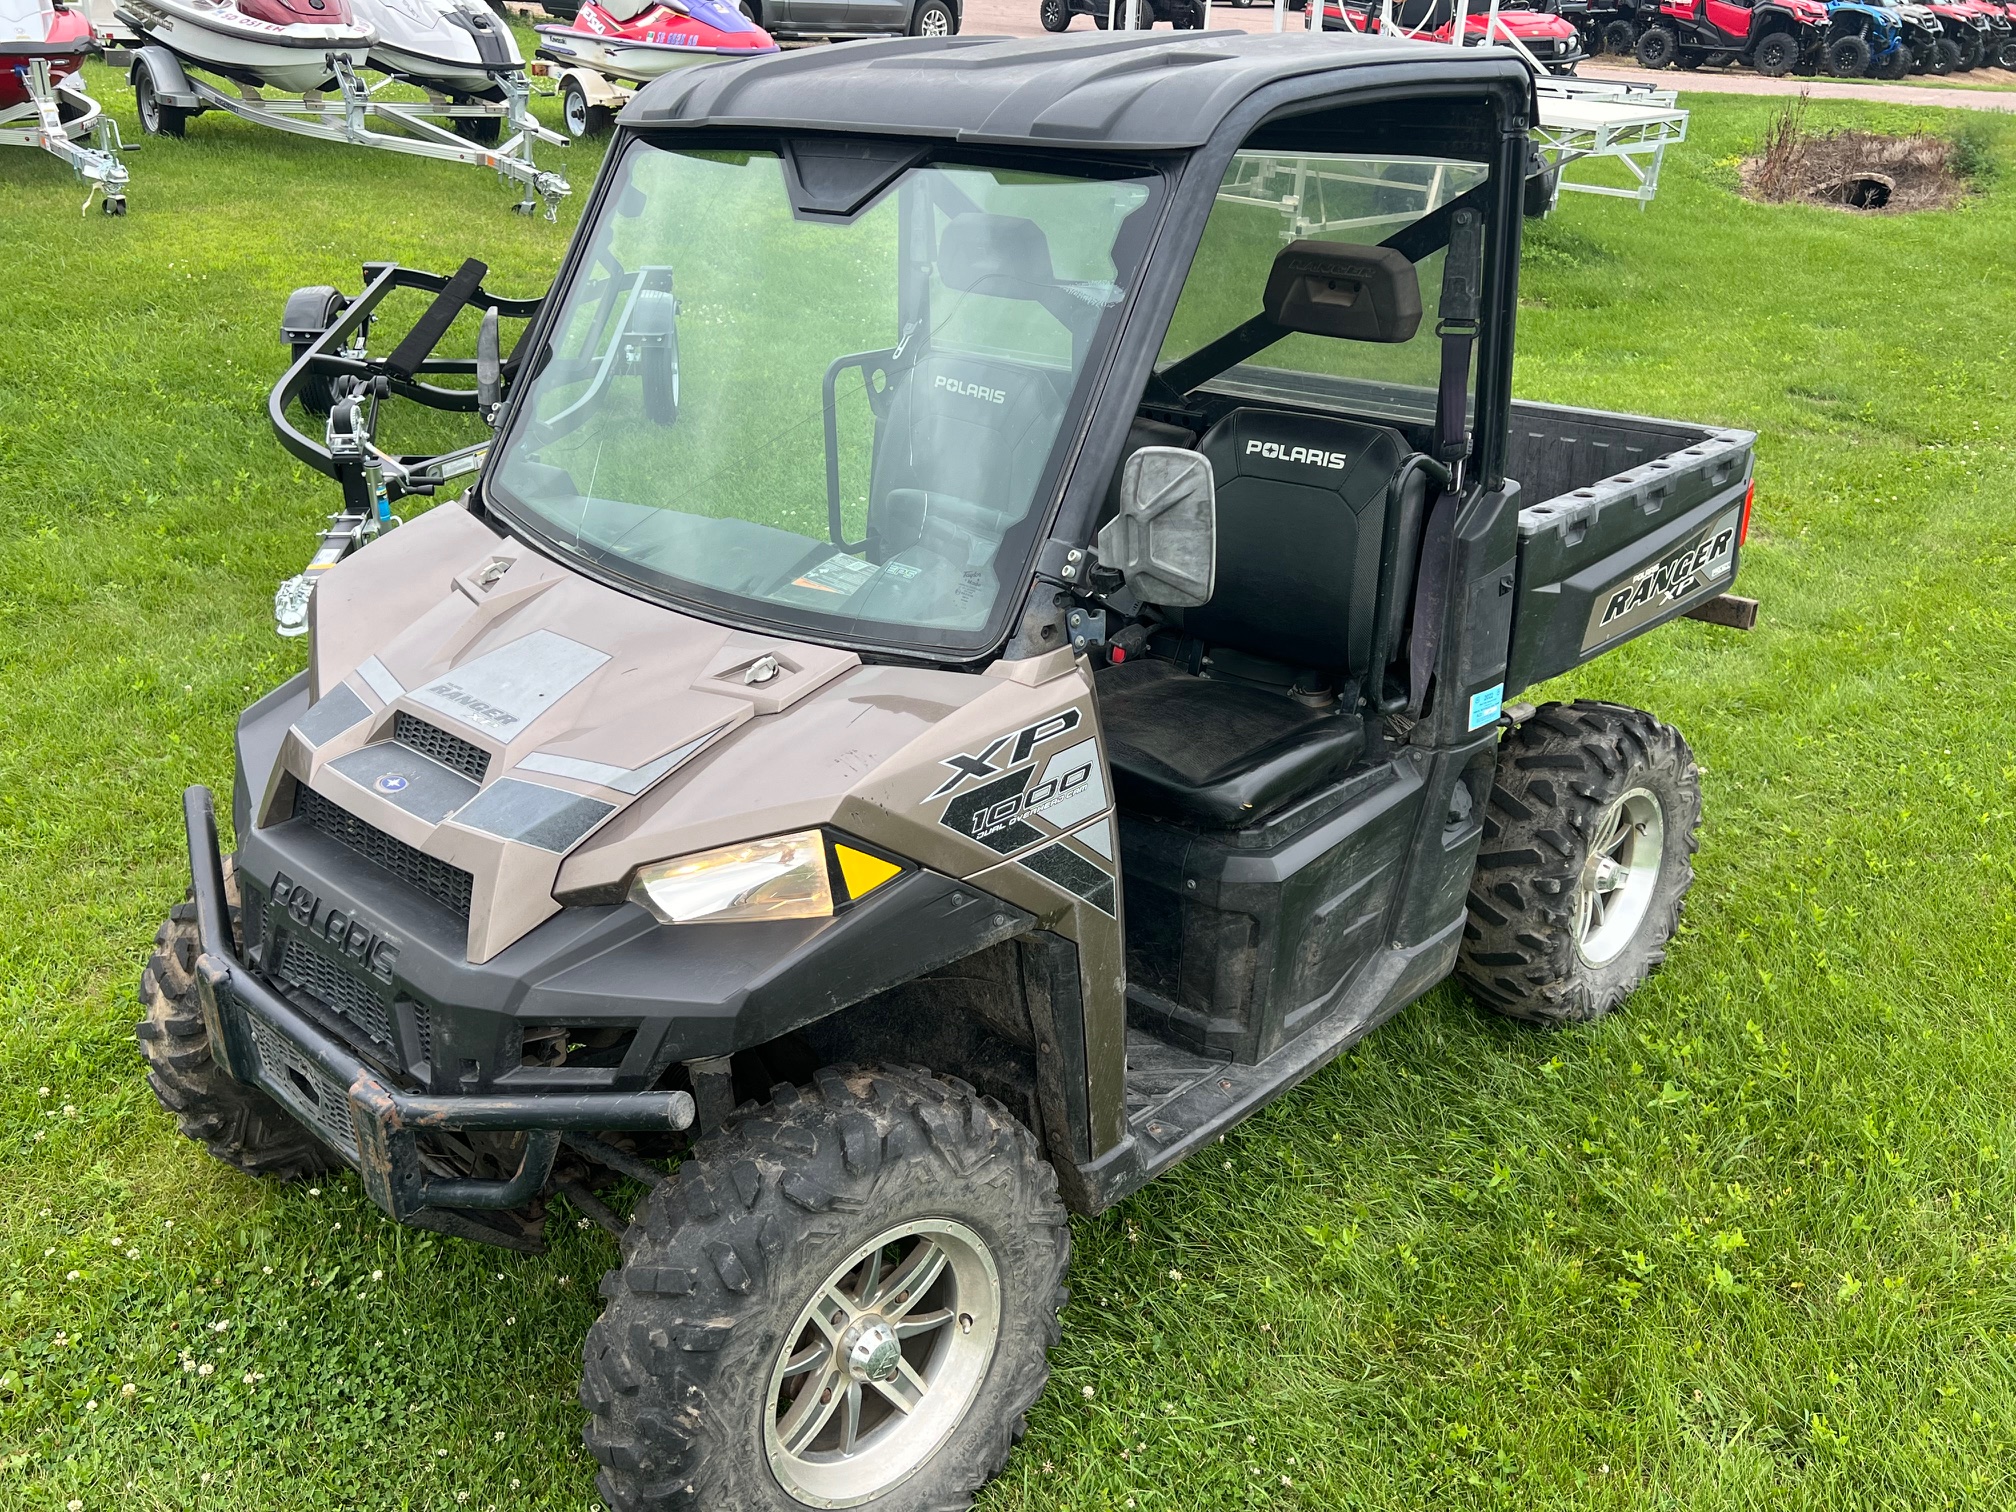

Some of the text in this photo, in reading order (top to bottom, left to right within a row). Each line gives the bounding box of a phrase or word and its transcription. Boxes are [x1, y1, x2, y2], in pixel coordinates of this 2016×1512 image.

[1288, 259, 1376, 279] RANGER
[934, 375, 1006, 404] POLARIS
[1245, 439, 1347, 470] POLARIS
[1598, 526, 1734, 628] RANGER
[1657, 575, 1696, 608] XP
[427, 684, 520, 726] RANGER
[919, 706, 1083, 805] XP
[971, 761, 1094, 834] 1000
[975, 783, 1088, 840] DUAL OVERHEAD CAM
[270, 870, 401, 985] POLARIS
